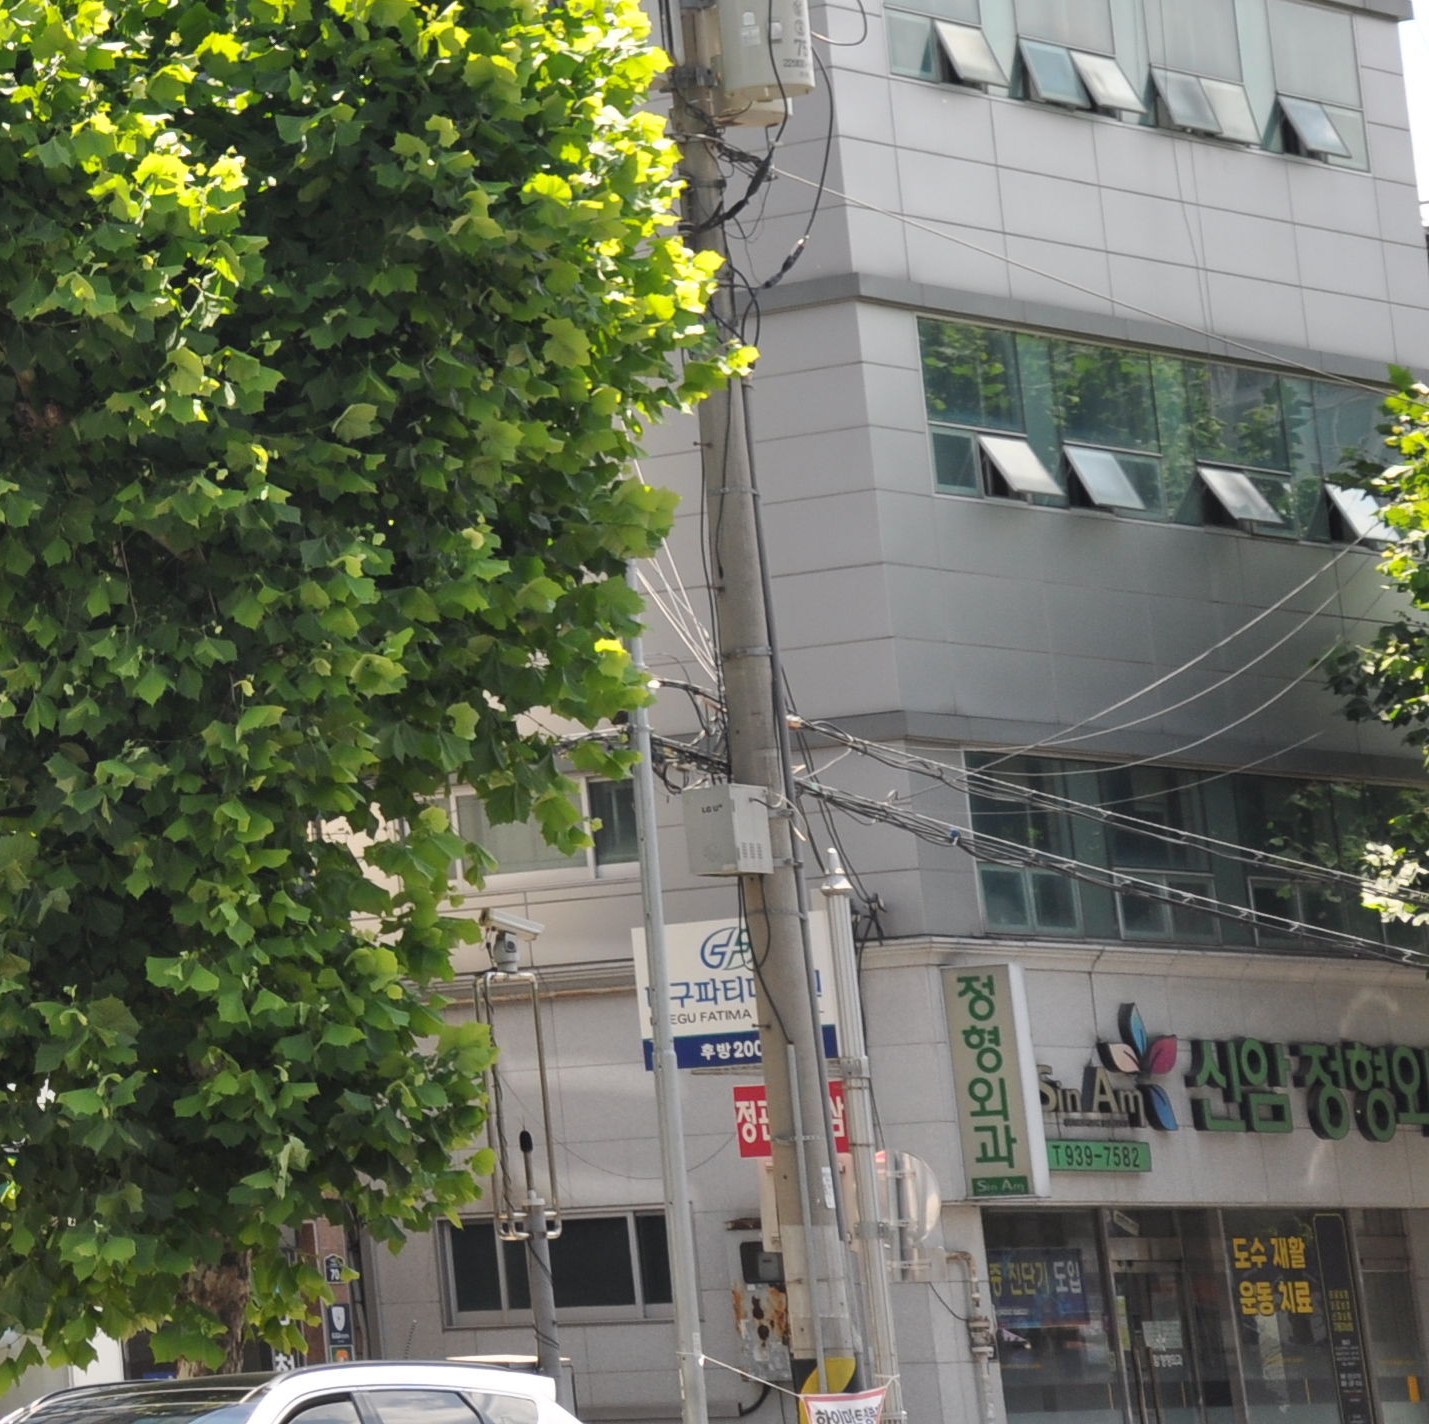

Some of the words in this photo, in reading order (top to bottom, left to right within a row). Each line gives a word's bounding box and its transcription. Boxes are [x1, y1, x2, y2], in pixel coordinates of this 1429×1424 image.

[700, 1008, 753, 1023] FATIMA
[701, 1040, 733, 1060] 후방
[957, 974, 1018, 1168] 정형외과
[1233, 1237, 1268, 1269] 도수
[1270, 1236, 1307, 1270] 재활
[1053, 1261, 1082, 1294] 도입
[1239, 1281, 1275, 1316] 운동
[1278, 1280, 1315, 1314] 치료
